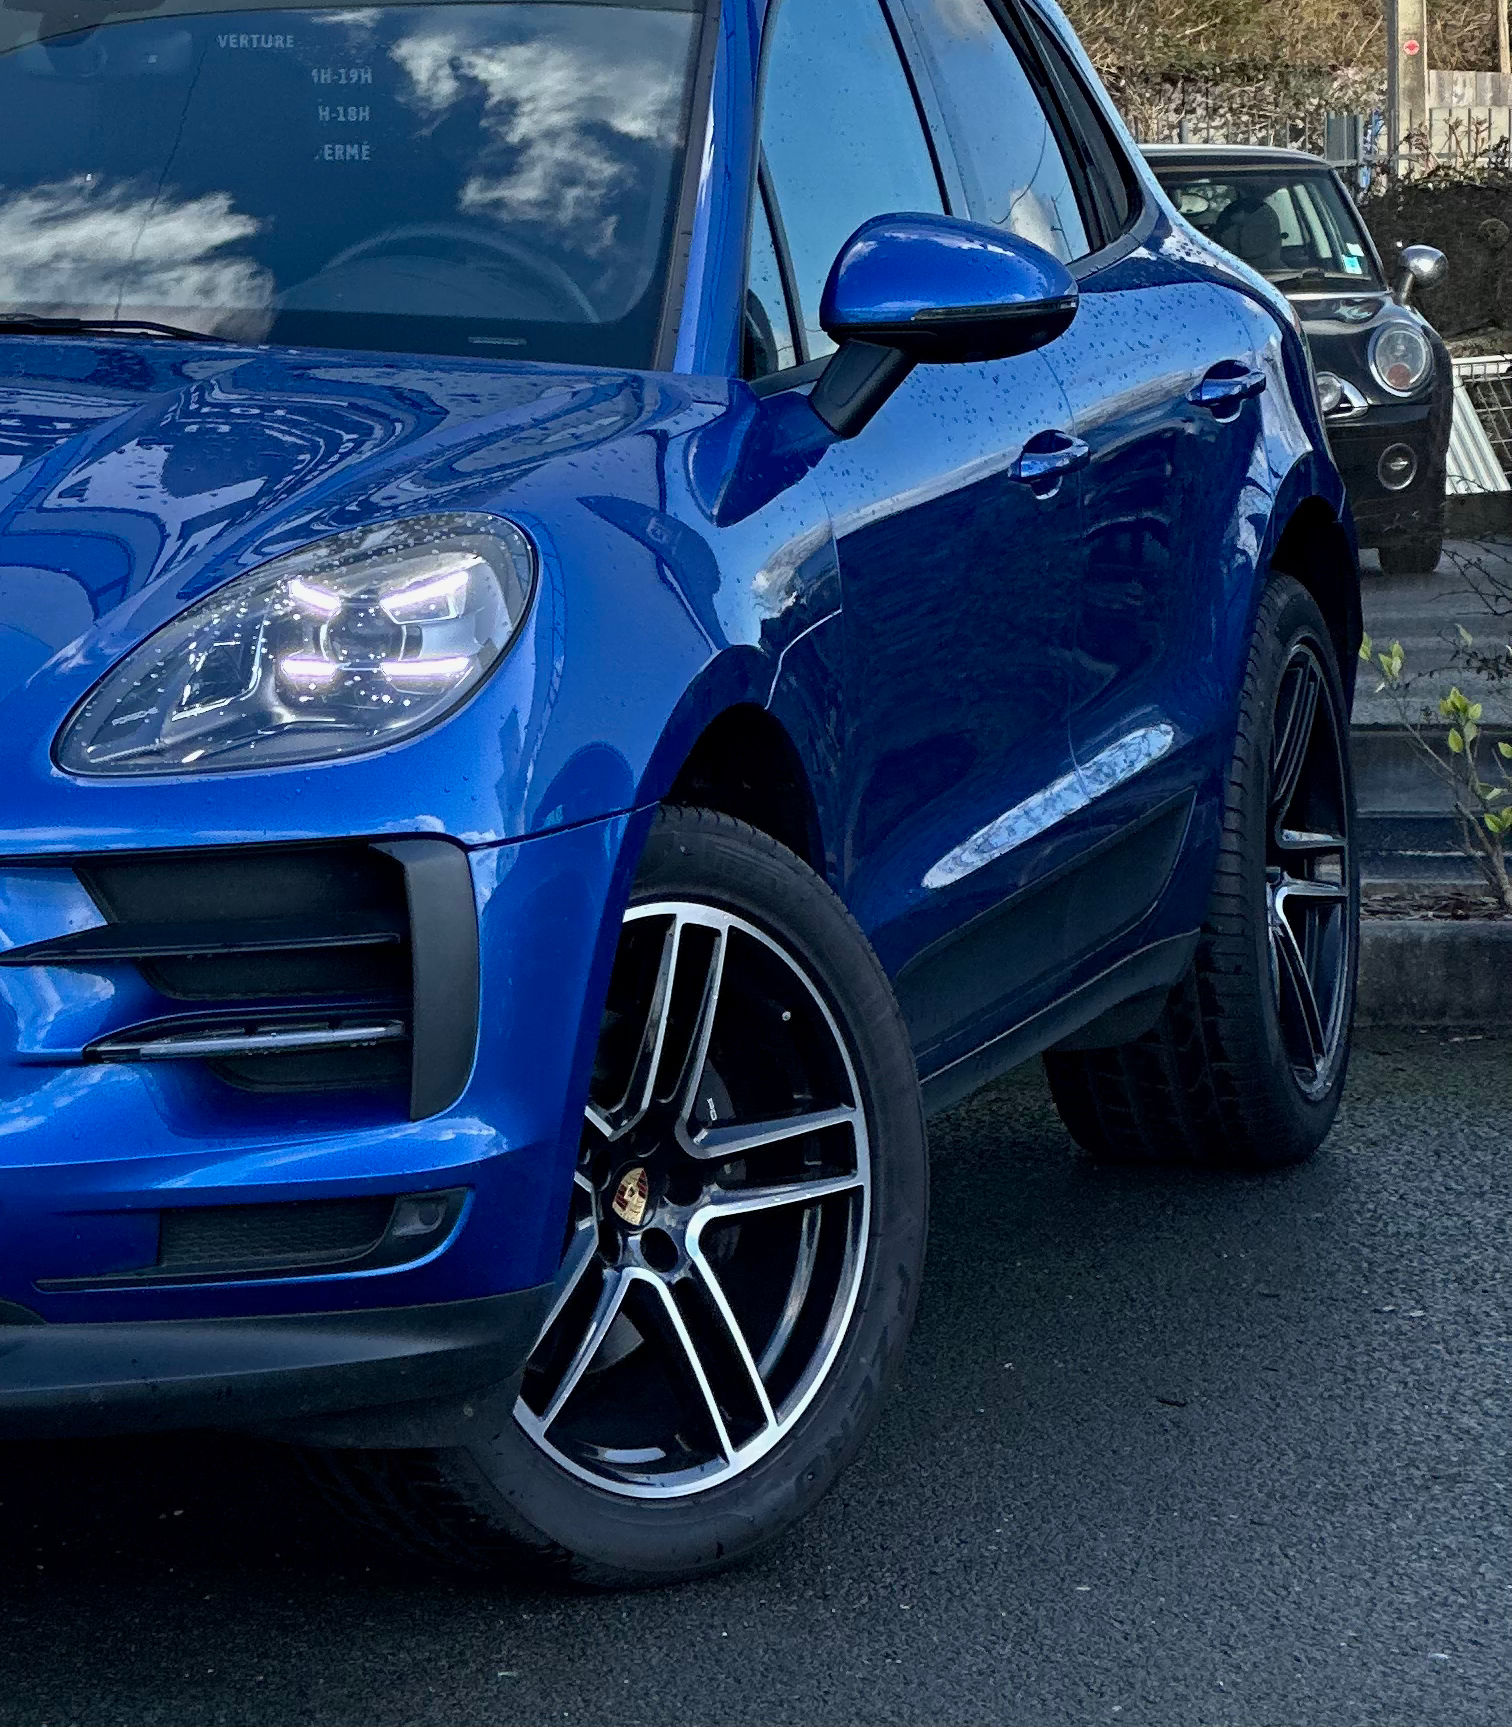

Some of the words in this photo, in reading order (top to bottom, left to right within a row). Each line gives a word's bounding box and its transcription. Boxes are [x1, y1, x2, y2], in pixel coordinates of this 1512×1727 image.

[217, 34, 294, 49] VERTURE
[318, 106, 370, 122] H-18H
[314, 141, 370, 161] ERMÉ
